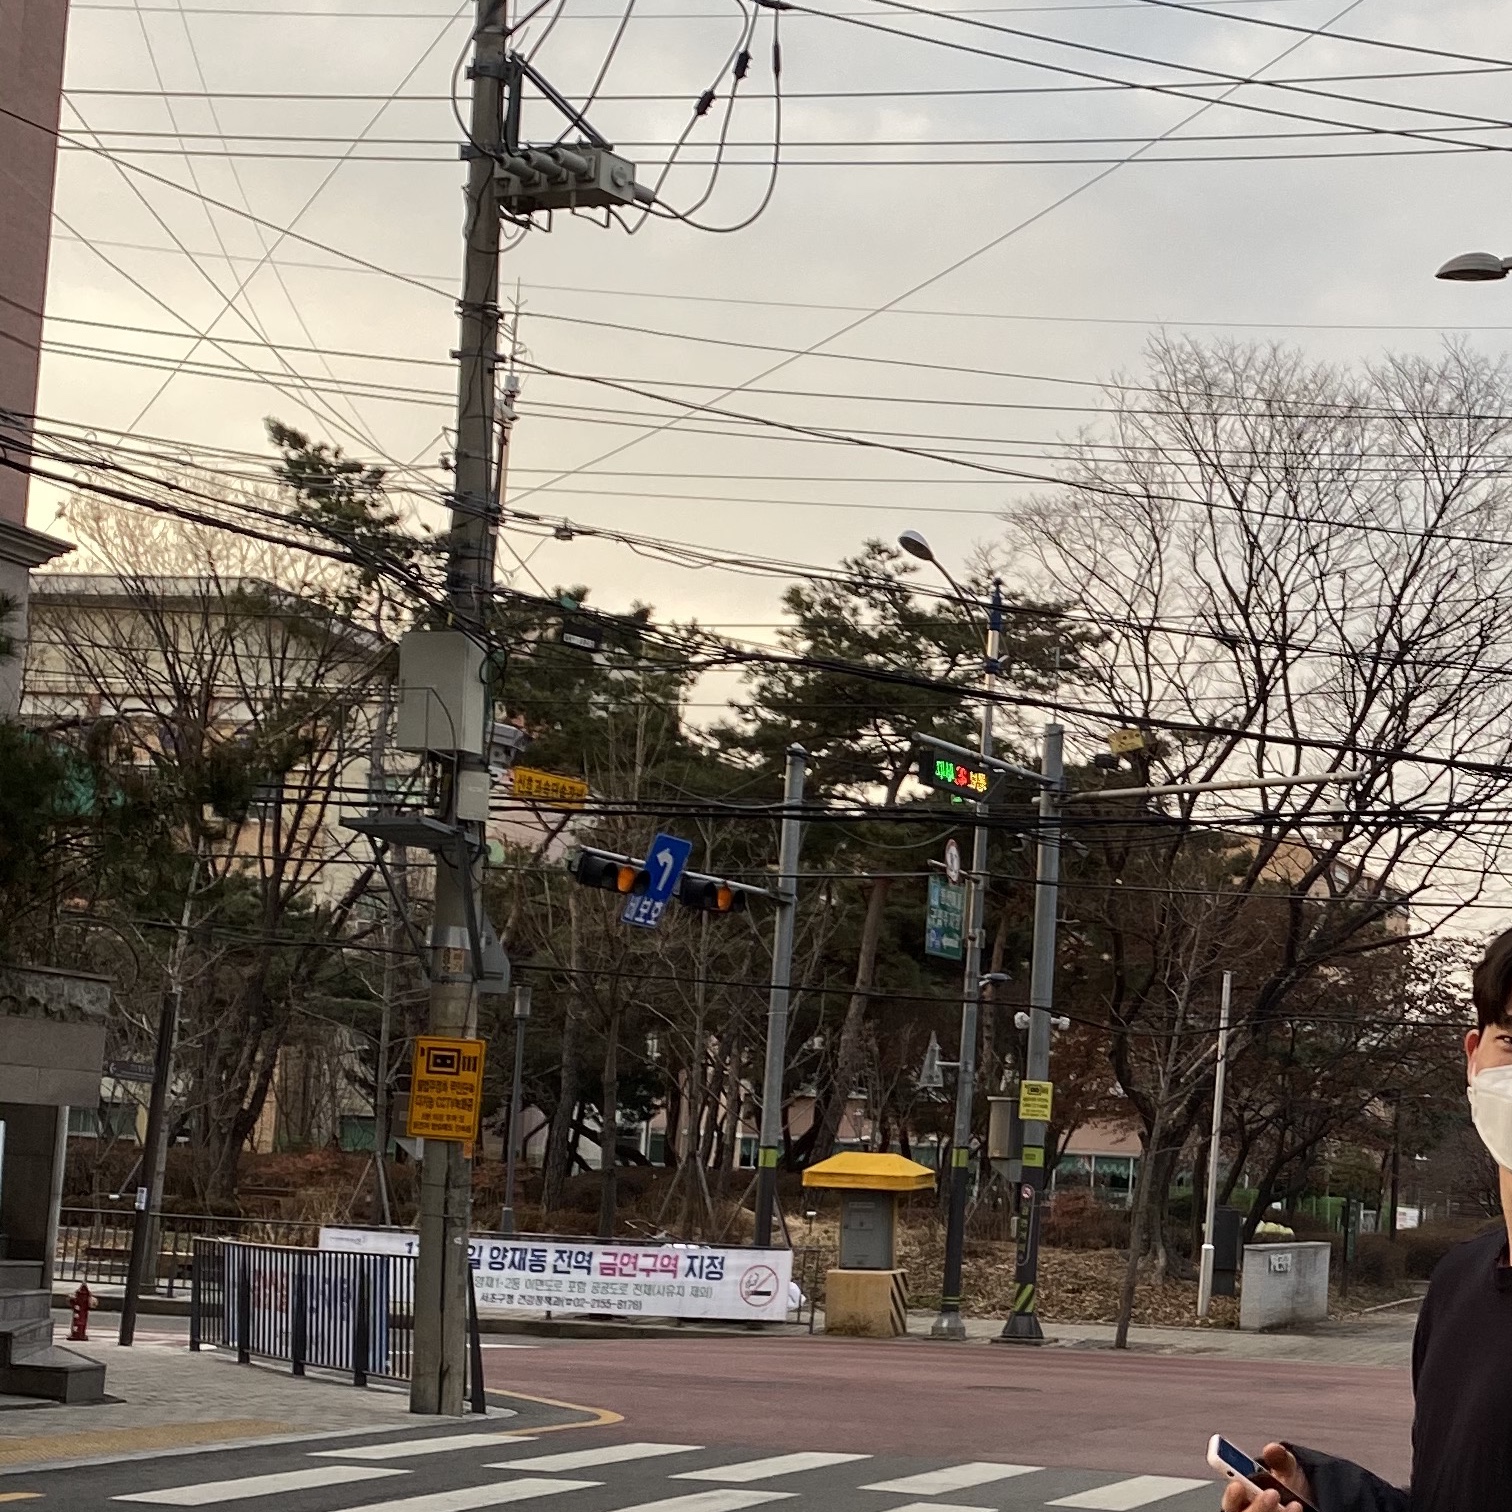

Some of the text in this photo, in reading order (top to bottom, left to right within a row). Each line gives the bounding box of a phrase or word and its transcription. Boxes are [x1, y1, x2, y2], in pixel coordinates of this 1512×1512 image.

[488, 1245, 548, 1273] 양재동
[552, 1249, 594, 1276] 전역
[598, 1251, 680, 1279] 금연구역
[684, 1254, 726, 1281] 지정
